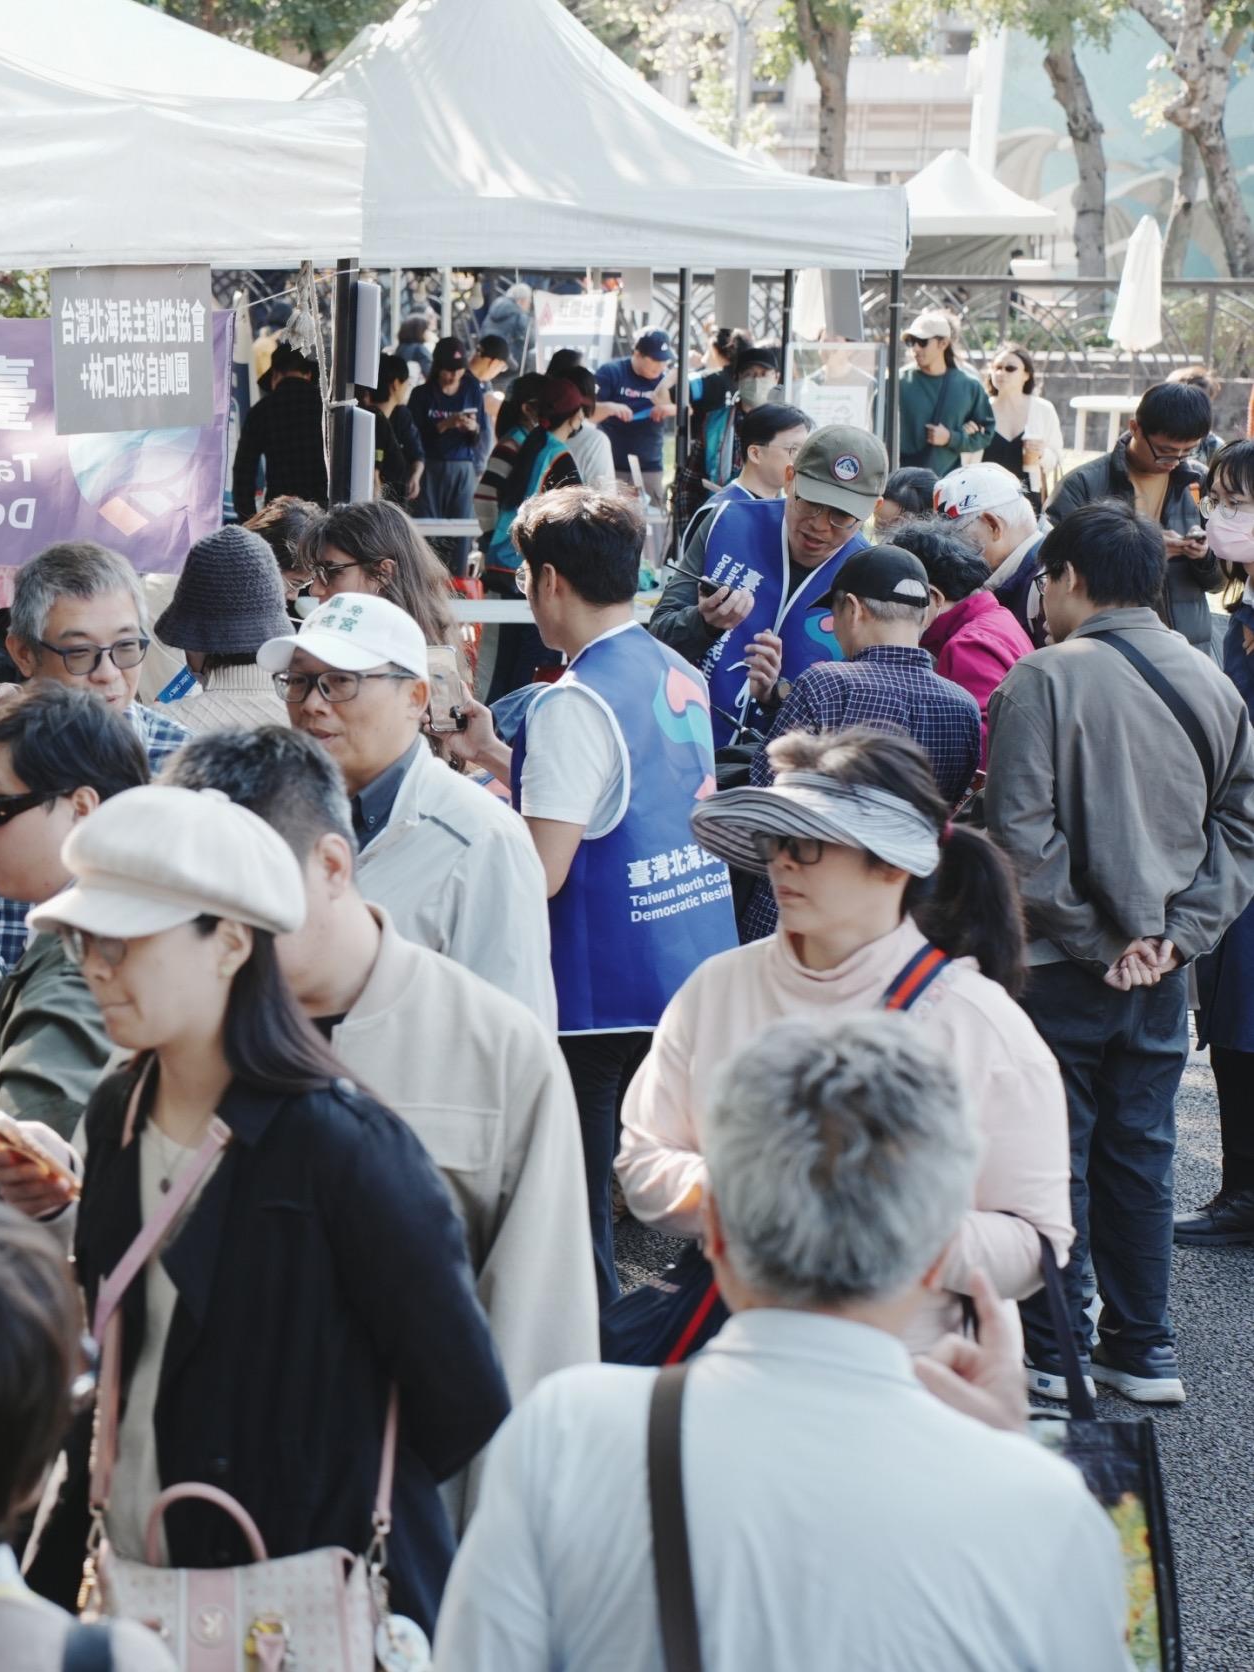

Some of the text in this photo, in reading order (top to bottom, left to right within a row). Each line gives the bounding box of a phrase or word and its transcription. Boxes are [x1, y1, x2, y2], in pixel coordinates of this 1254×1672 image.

[61, 297, 206, 344] 台灣北海民主韌性協會
[80, 352, 190, 399] +林口防災自訓團
[630, 889, 676, 907] Taiwan
[677, 876, 704, 896] North
[631, 895, 700, 922] Democratic
